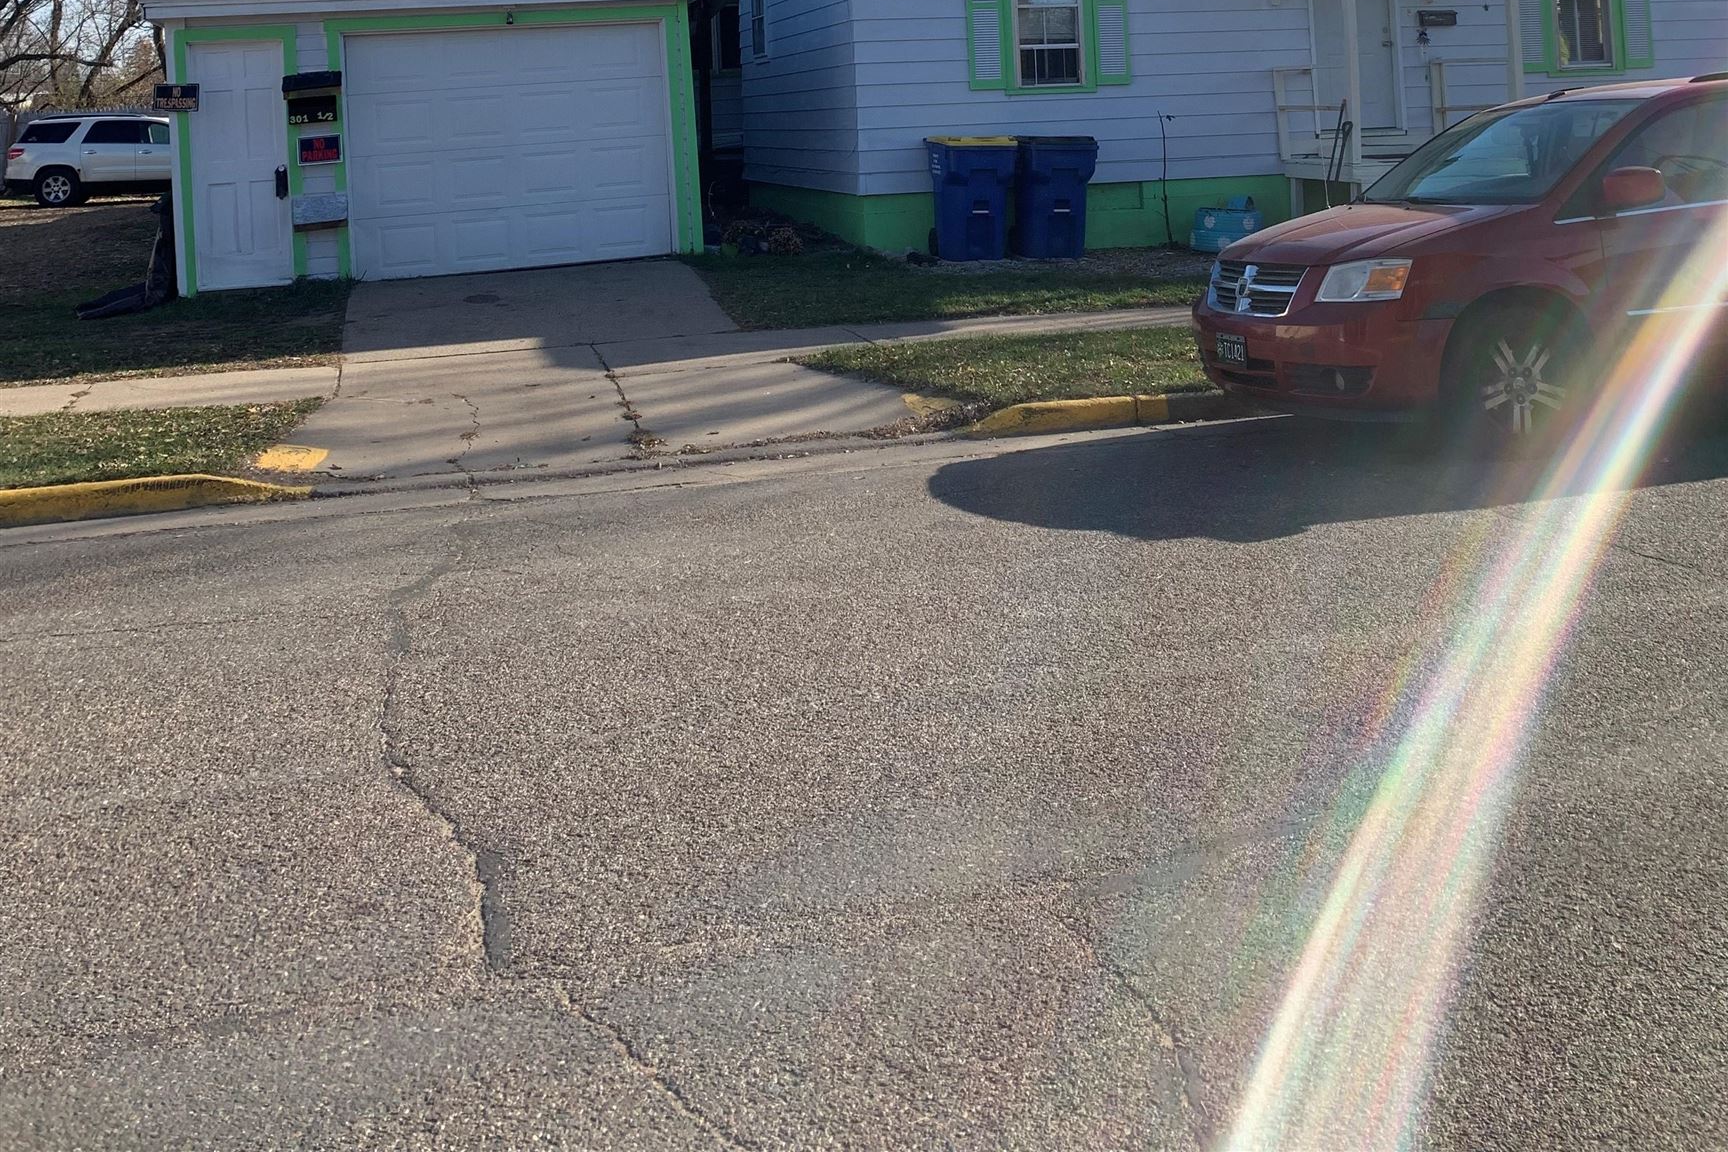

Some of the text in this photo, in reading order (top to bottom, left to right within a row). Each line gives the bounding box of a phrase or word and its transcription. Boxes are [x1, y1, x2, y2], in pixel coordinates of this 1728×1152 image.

[172, 87, 181, 97] NO
[156, 97, 197, 109] TRESPASSING
[289, 111, 334, 124] 301 1/2
[314, 138, 325, 149] NO
[302, 149, 338, 161] PARKING
